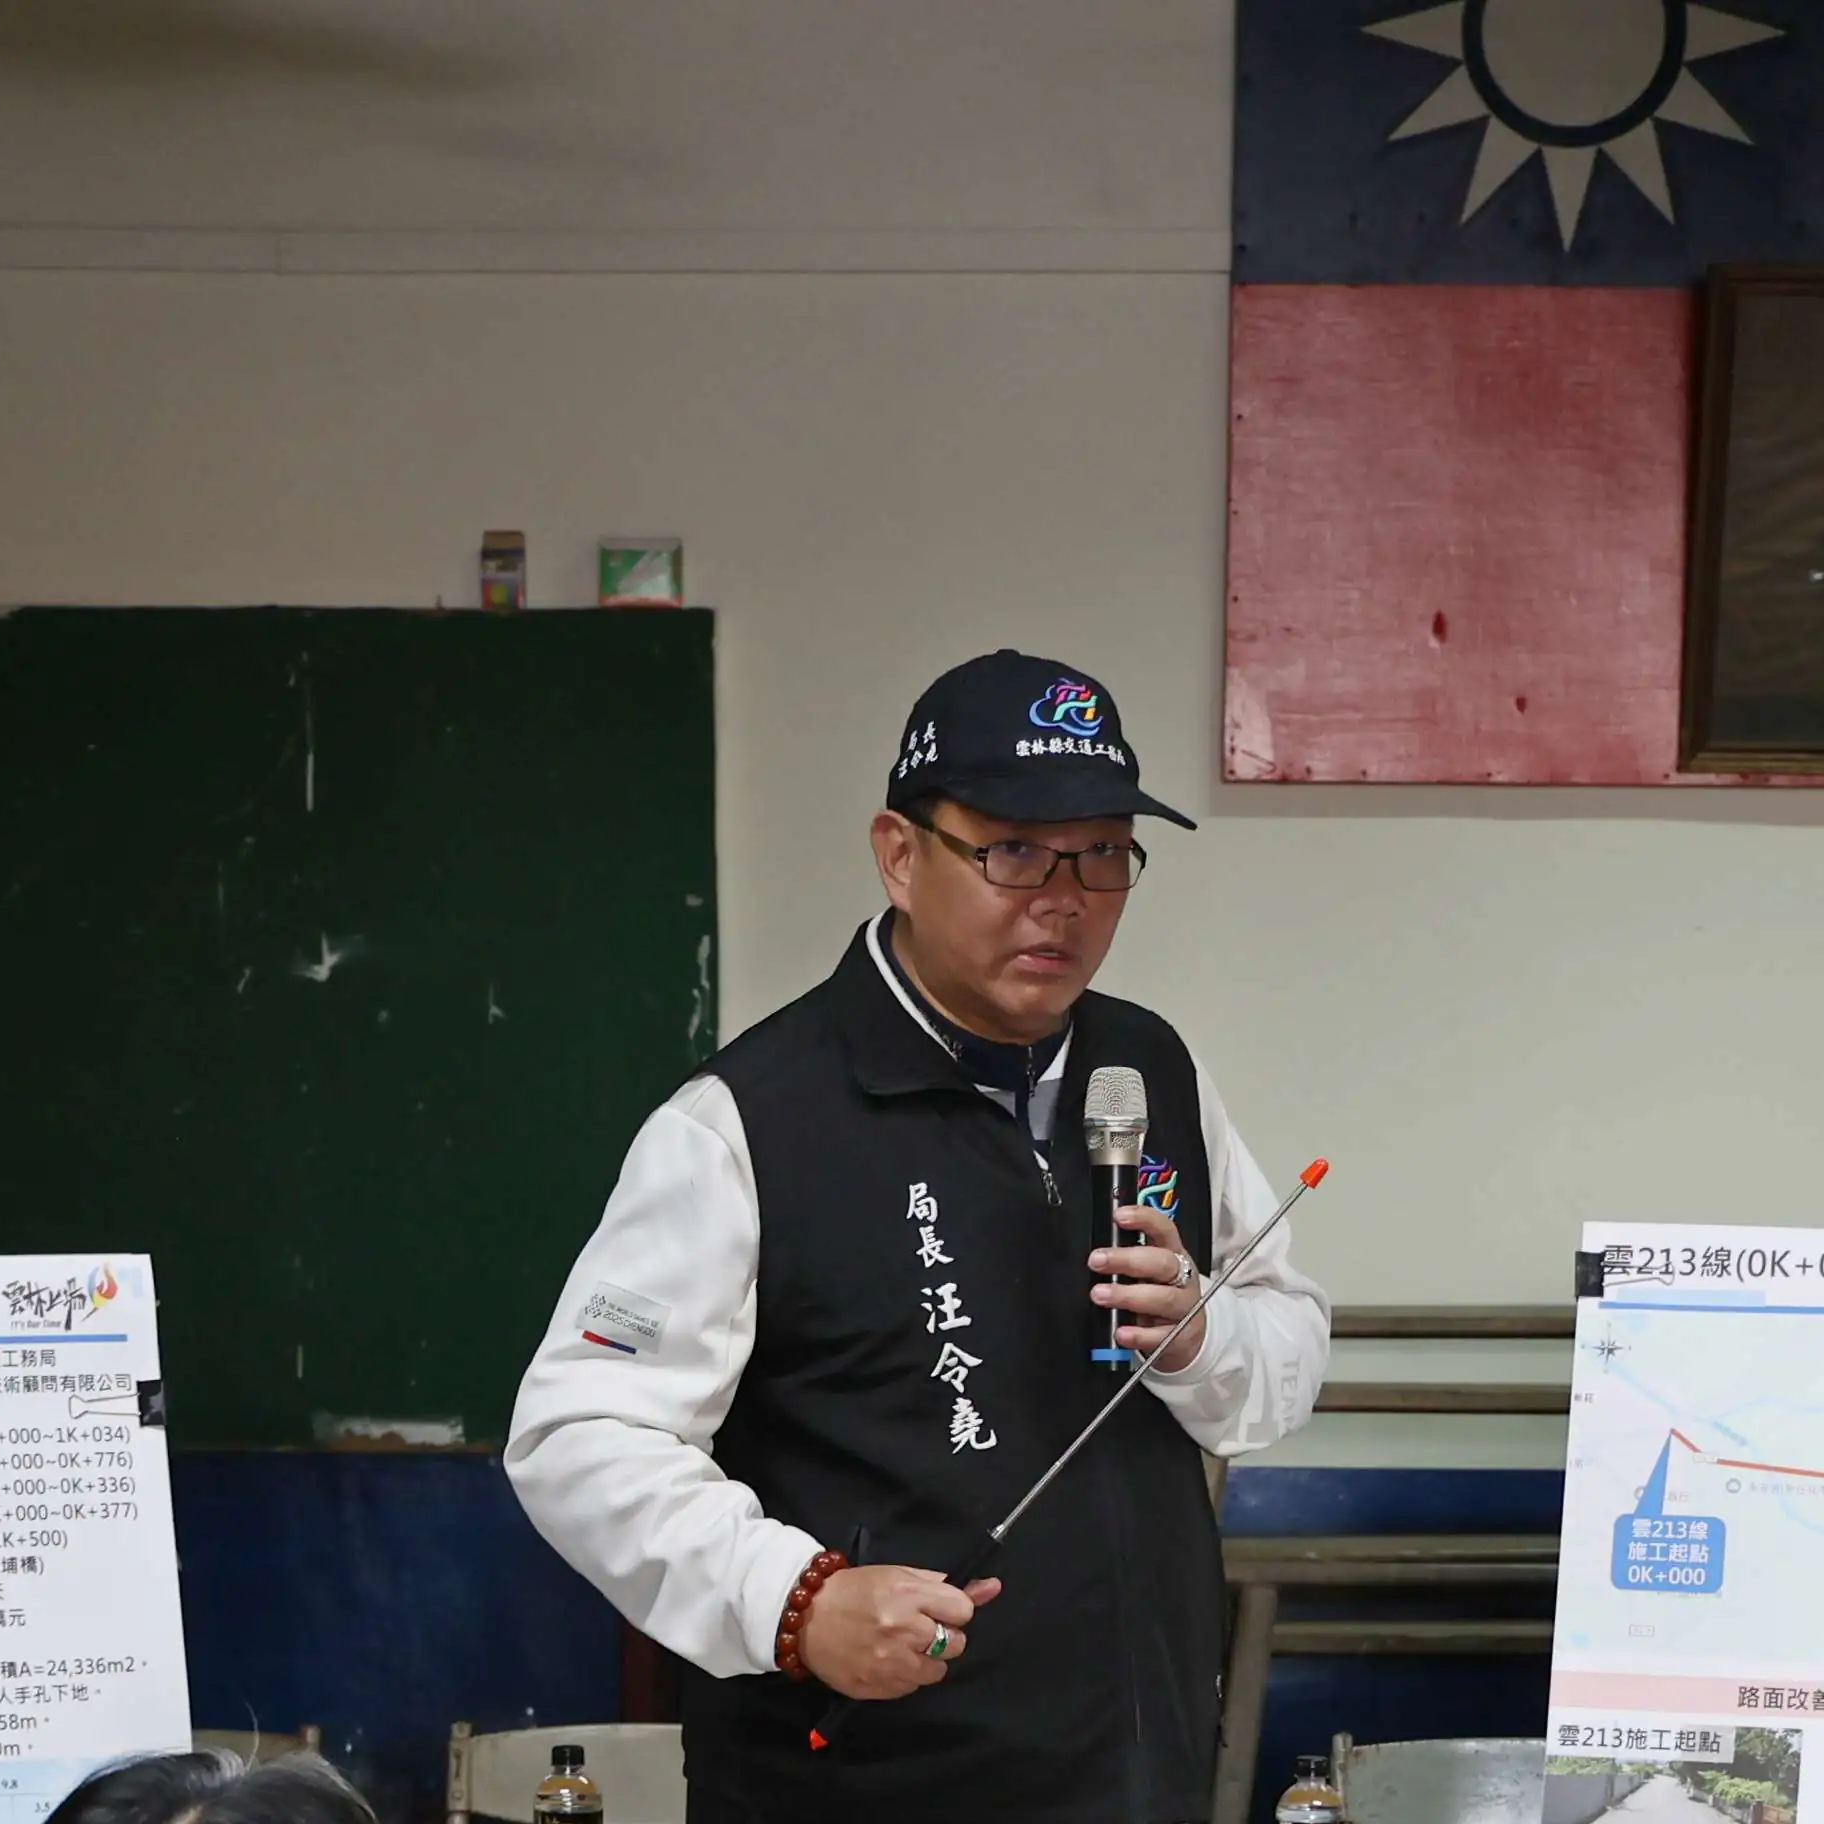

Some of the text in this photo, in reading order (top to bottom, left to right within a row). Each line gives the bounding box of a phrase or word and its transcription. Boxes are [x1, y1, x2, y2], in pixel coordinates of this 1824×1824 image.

[906, 1181, 999, 1455] 局長 汪令堯
[1632, 1518, 1709, 1540] 雲213線
[1627, 1541, 1710, 1563] 施工起點
[1628, 1565, 1706, 1586] 0K+000
[1557, 1723, 1722, 1754] 雲213施工起點
[1, 1779, 19, 1790] 9.8
